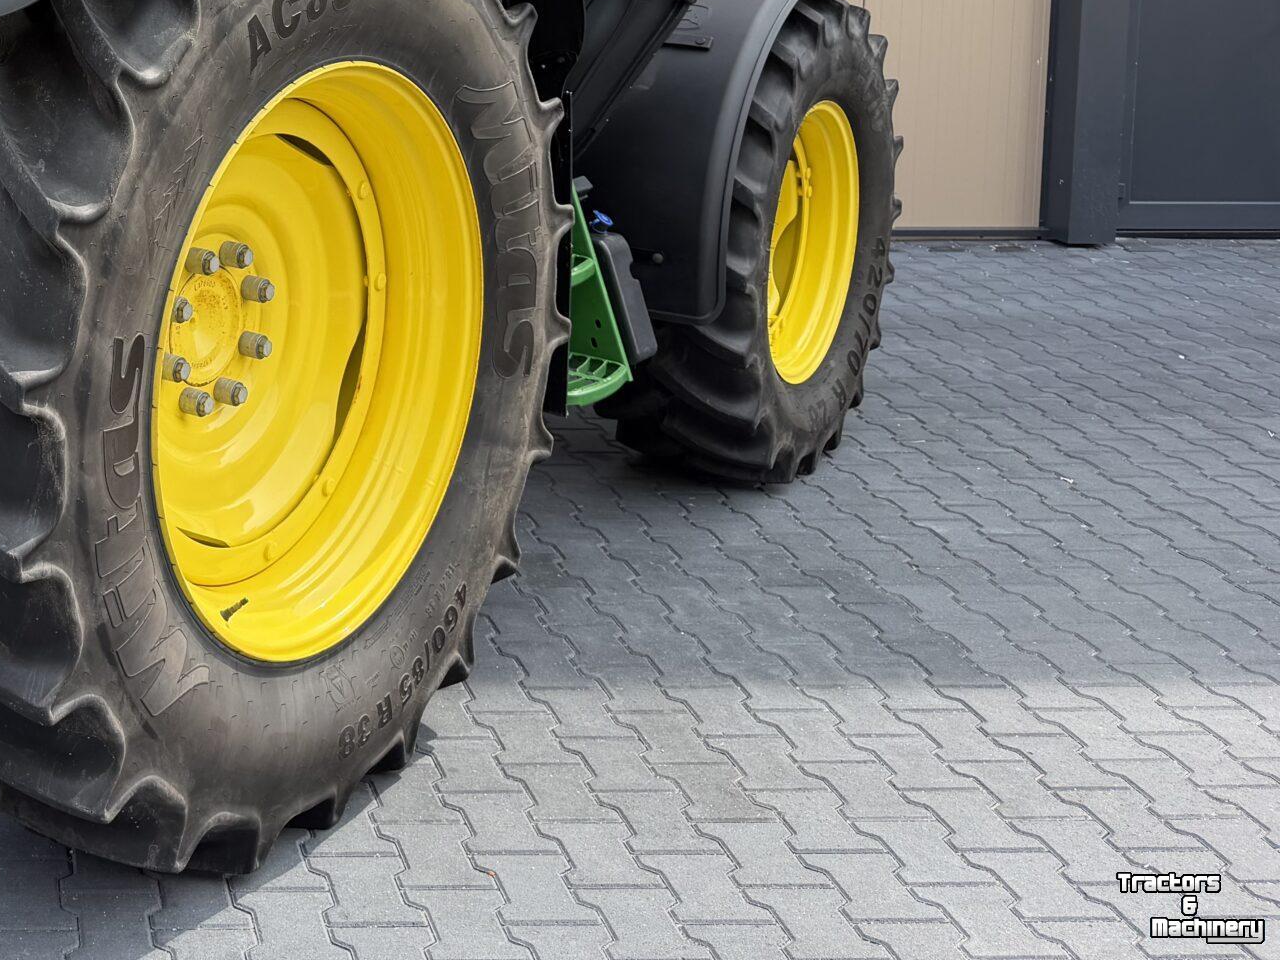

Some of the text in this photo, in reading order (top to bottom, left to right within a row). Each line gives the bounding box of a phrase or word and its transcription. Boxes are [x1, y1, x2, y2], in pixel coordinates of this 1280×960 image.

[456, 80, 542, 380] Mitas
[846, 238, 885, 377] 420/70
[94, 333, 210, 718] Mitas
[375, 692, 393, 729] R
[398, 581, 468, 708] 460/85
[337, 713, 371, 760] 38
